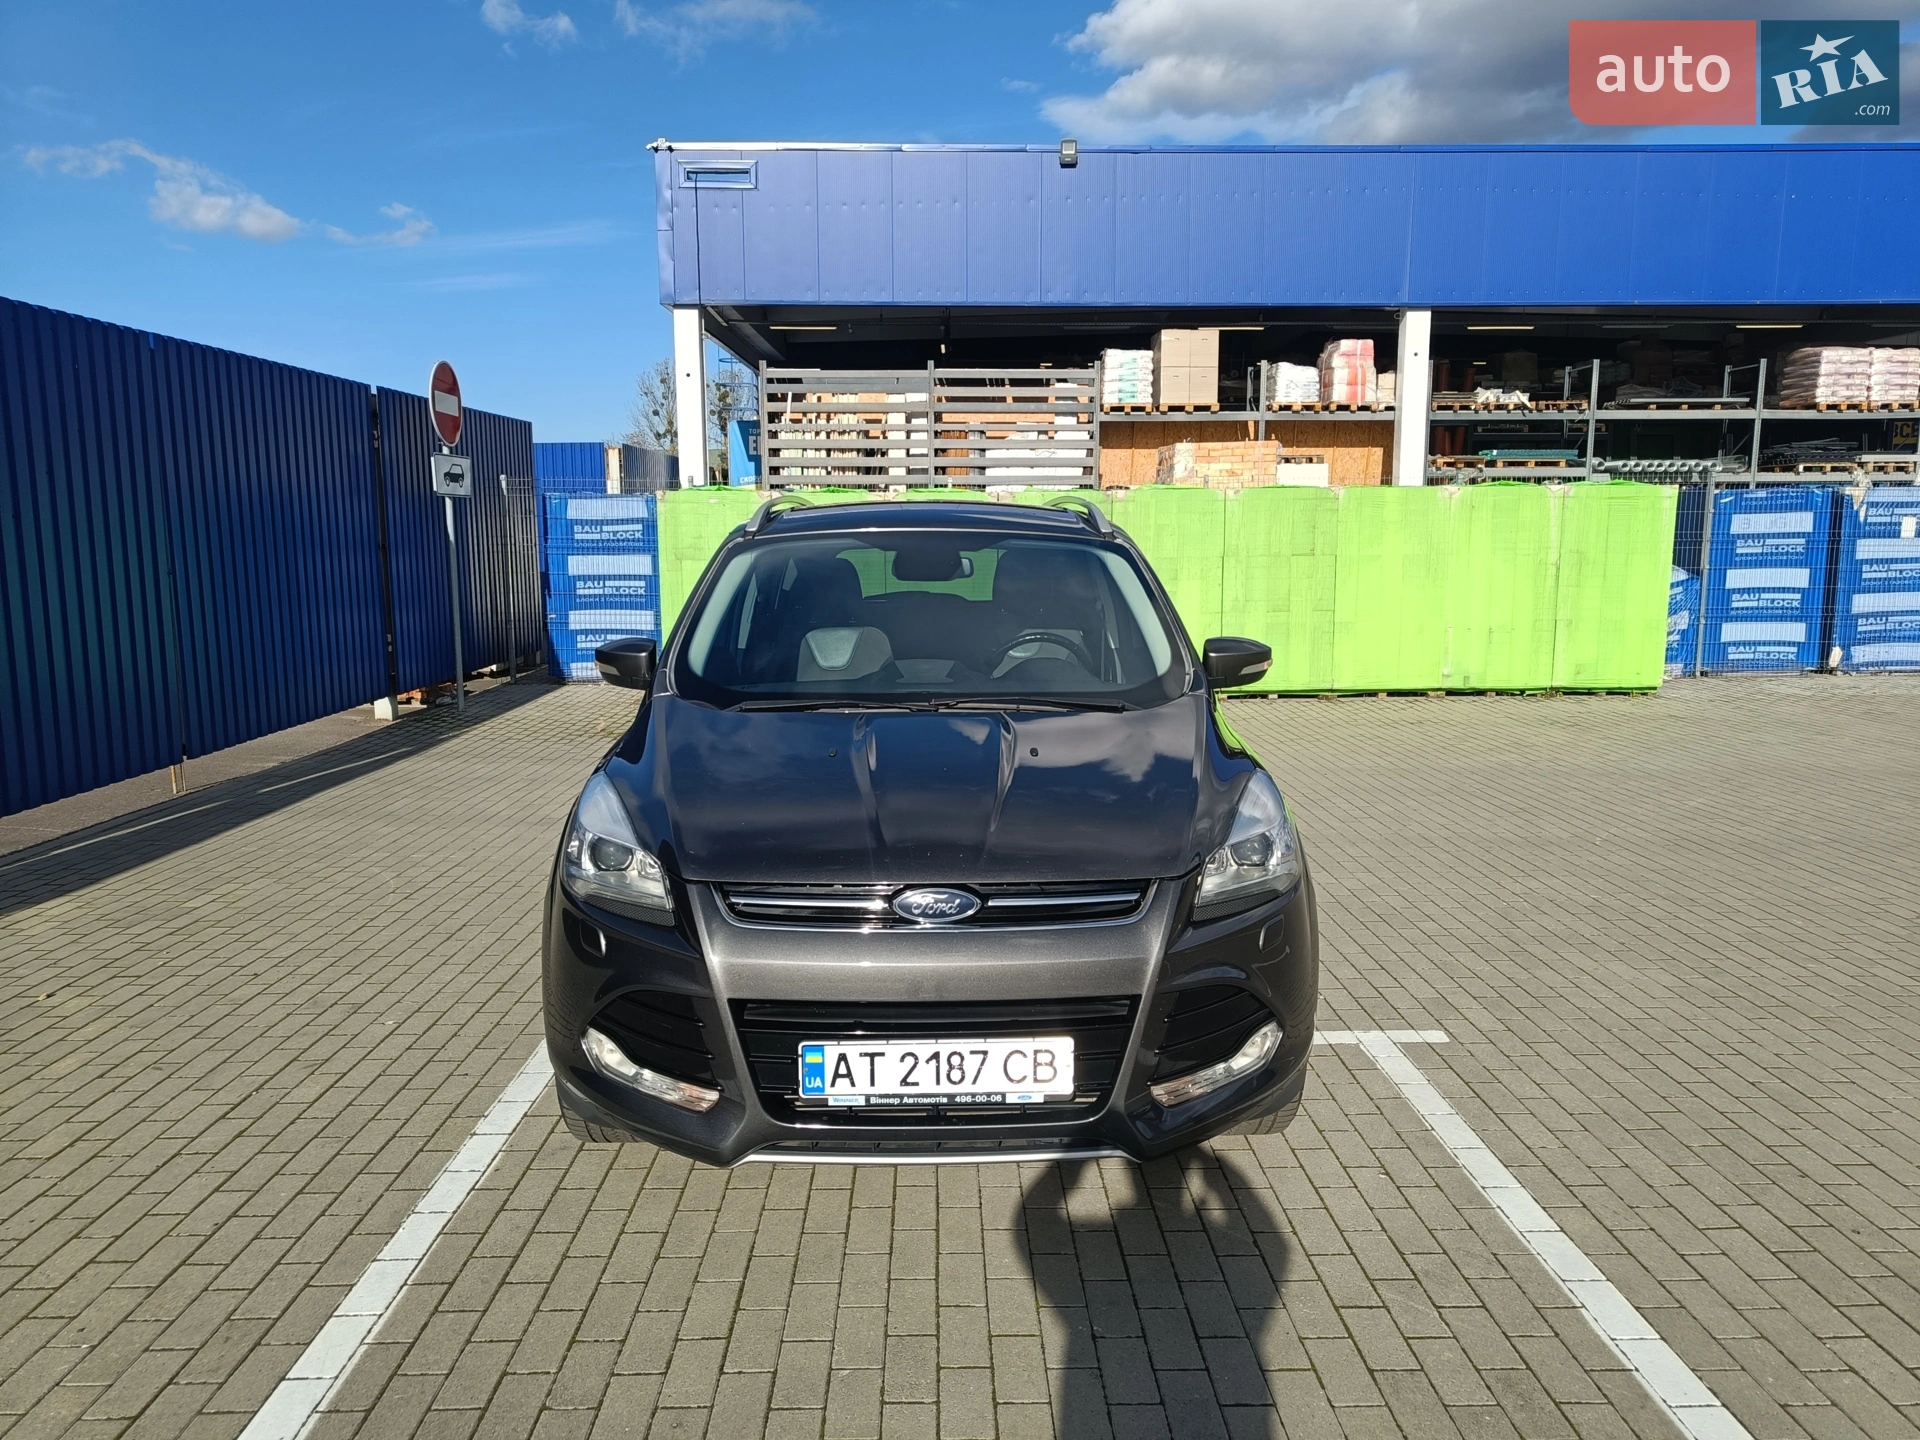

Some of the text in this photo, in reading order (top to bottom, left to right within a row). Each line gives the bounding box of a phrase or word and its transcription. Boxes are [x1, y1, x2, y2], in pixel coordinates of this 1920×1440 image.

[574, 525, 600, 533] BAU
[601, 531, 643, 540] BLOCK
[1763, 545, 1805, 553] BLOCK
[1888, 570, 1920, 578] BLOC
[604, 587, 646, 595] BLOCK
[1858, 617, 1886, 625] BAU
[577, 634, 604, 642] BAU
[911, 893, 961, 914] Ford
[830, 1049, 1058, 1088] AT 2187 CB
[805, 1077, 822, 1088] UA
[870, 1096, 900, 1105] Віннер
[954, 1095, 1003, 1103] 496-00-06
